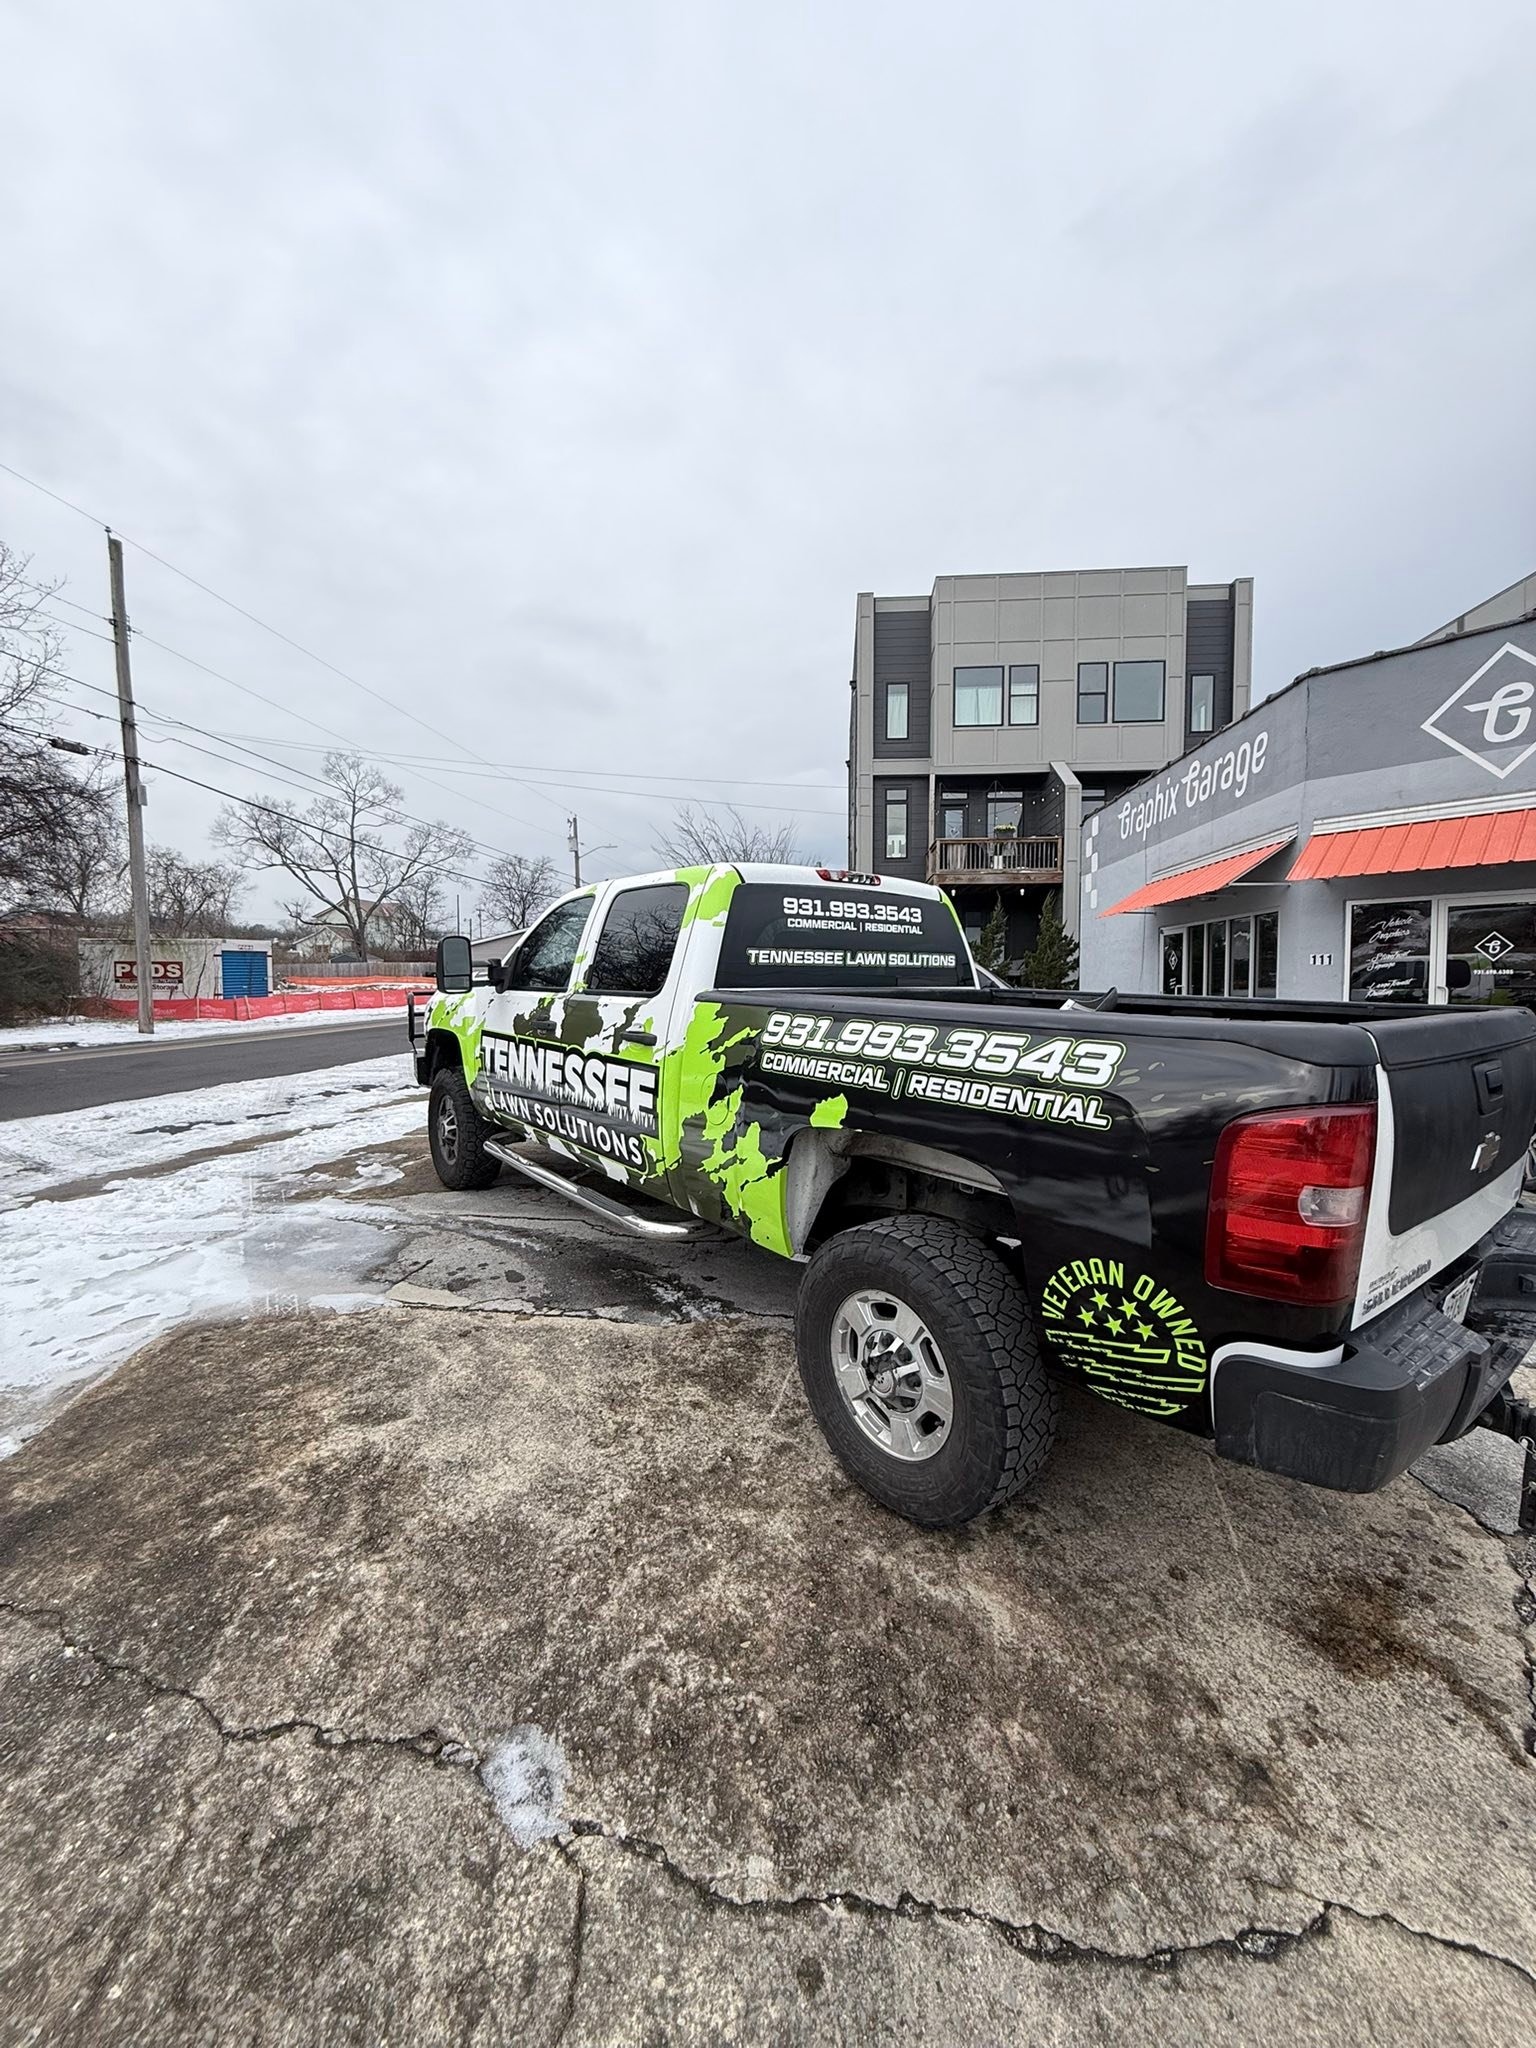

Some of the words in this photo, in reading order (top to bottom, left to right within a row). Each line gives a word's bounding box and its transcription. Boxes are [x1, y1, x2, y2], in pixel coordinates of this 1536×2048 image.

[1117, 777, 1180, 842] Graphix
[1181, 731, 1269, 809] Garage
[783, 897, 923, 923] 931.993.3543
[787, 917, 858, 931] COMMERCIAL
[864, 923, 923, 935] RESIDENTIAL
[747, 950, 844, 965] TENNESSEE
[846, 952, 887, 966] LAWN
[888, 954, 957, 967] SOLUTIONS
[1311, 954, 1332, 965] 111
[482, 1035, 656, 1130] TENNESSEE
[762, 1012, 1125, 1088] 931.993.3543
[491, 1087, 532, 1121] LAWN
[534, 1103, 643, 1165] SOLUTIONS
[761, 1051, 890, 1091] COMMERCIAL
[907, 1073, 1111, 1128] RESIDENTIAL
[1041, 1257, 1124, 1320] VETERAN
[1132, 1274, 1207, 1373] OWNED
